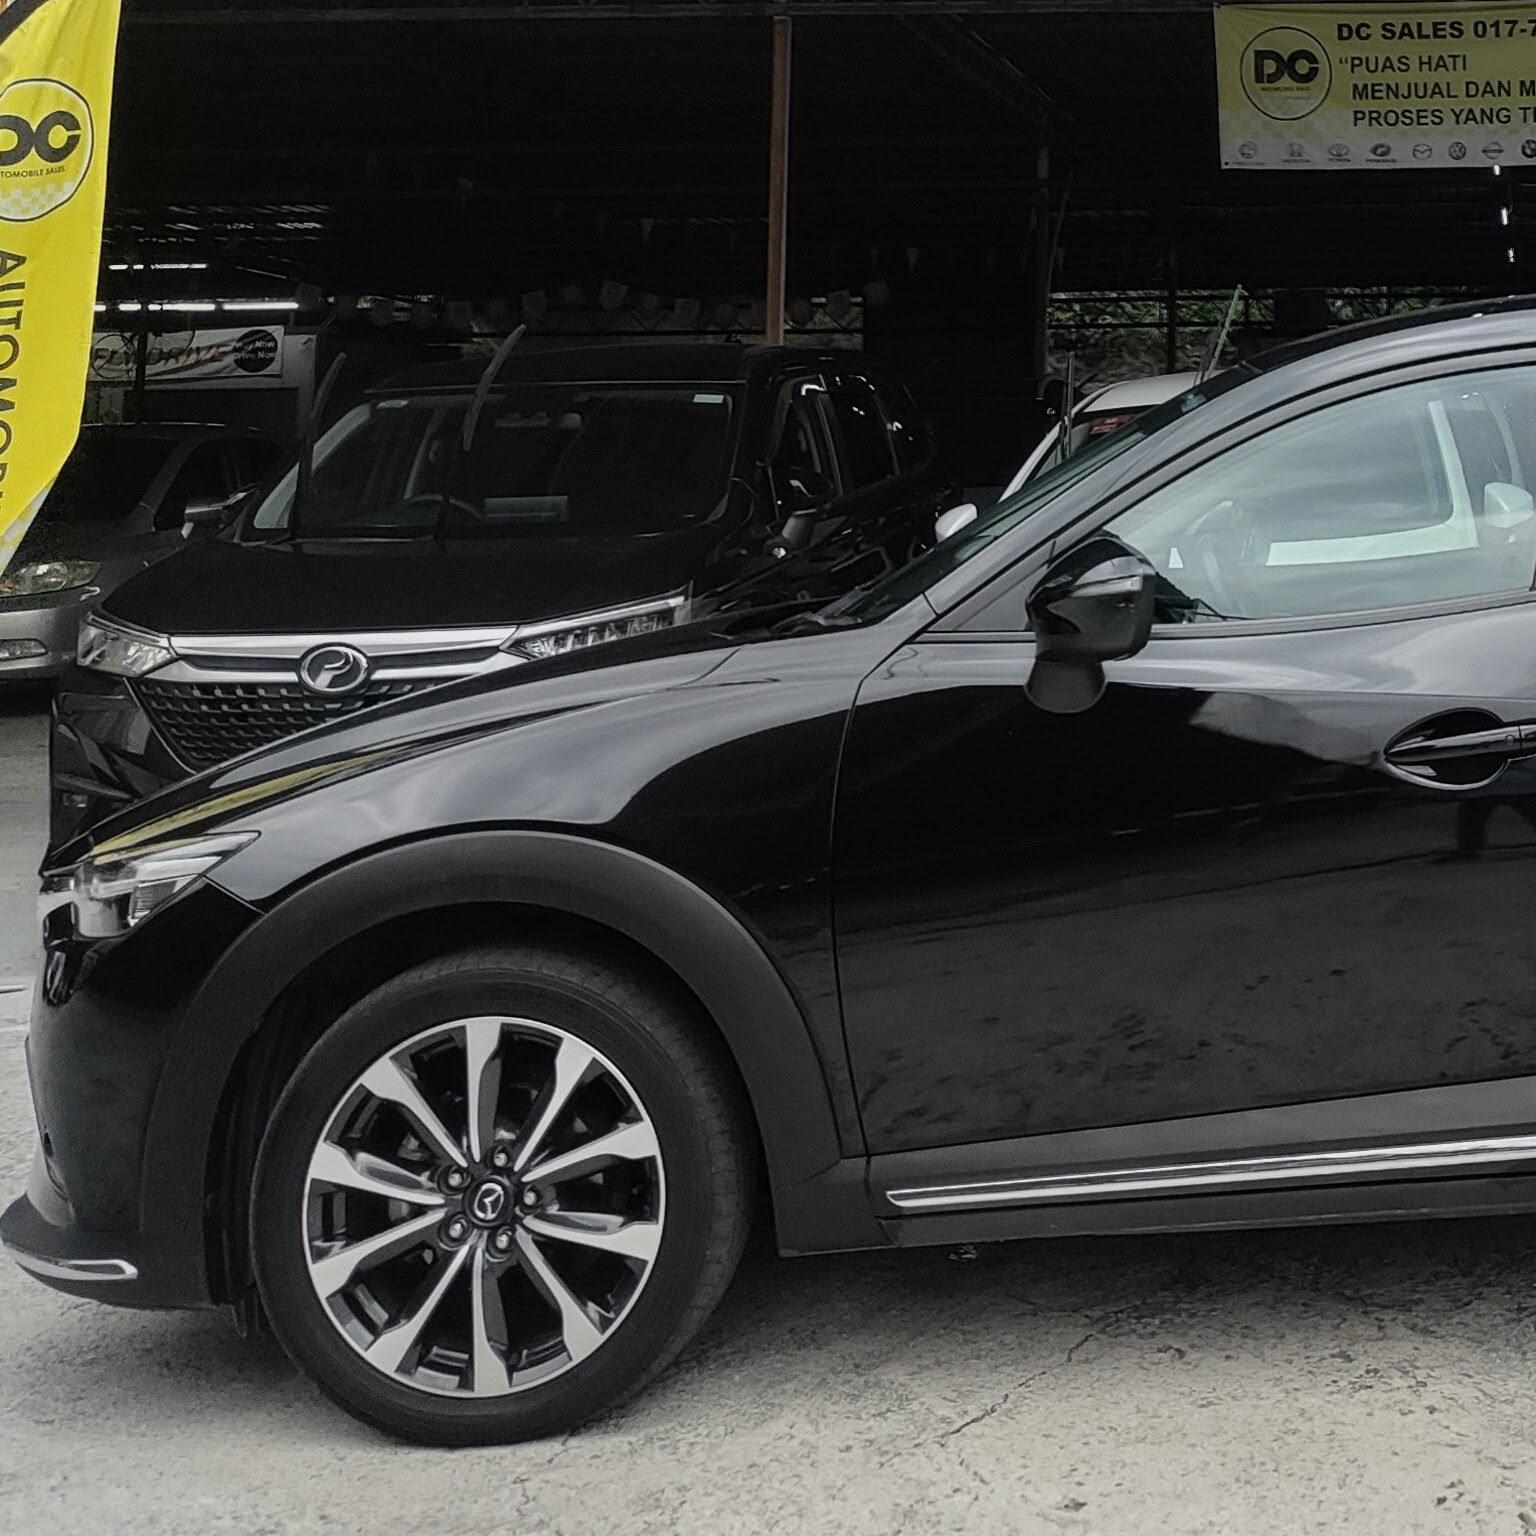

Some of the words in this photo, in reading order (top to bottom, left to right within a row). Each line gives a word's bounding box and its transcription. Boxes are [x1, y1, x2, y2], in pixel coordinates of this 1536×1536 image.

[1337, 22, 1372, 41] DC
[1380, 20, 1465, 40] SALES
[1254, 49, 1319, 84] DC
[1418, 53, 1467, 72] HATI
[1352, 81, 1459, 101] MENJUAL
[1465, 80, 1514, 98] DAN
[1353, 108, 1444, 127] PROSES
[1451, 107, 1512, 125] YANG
